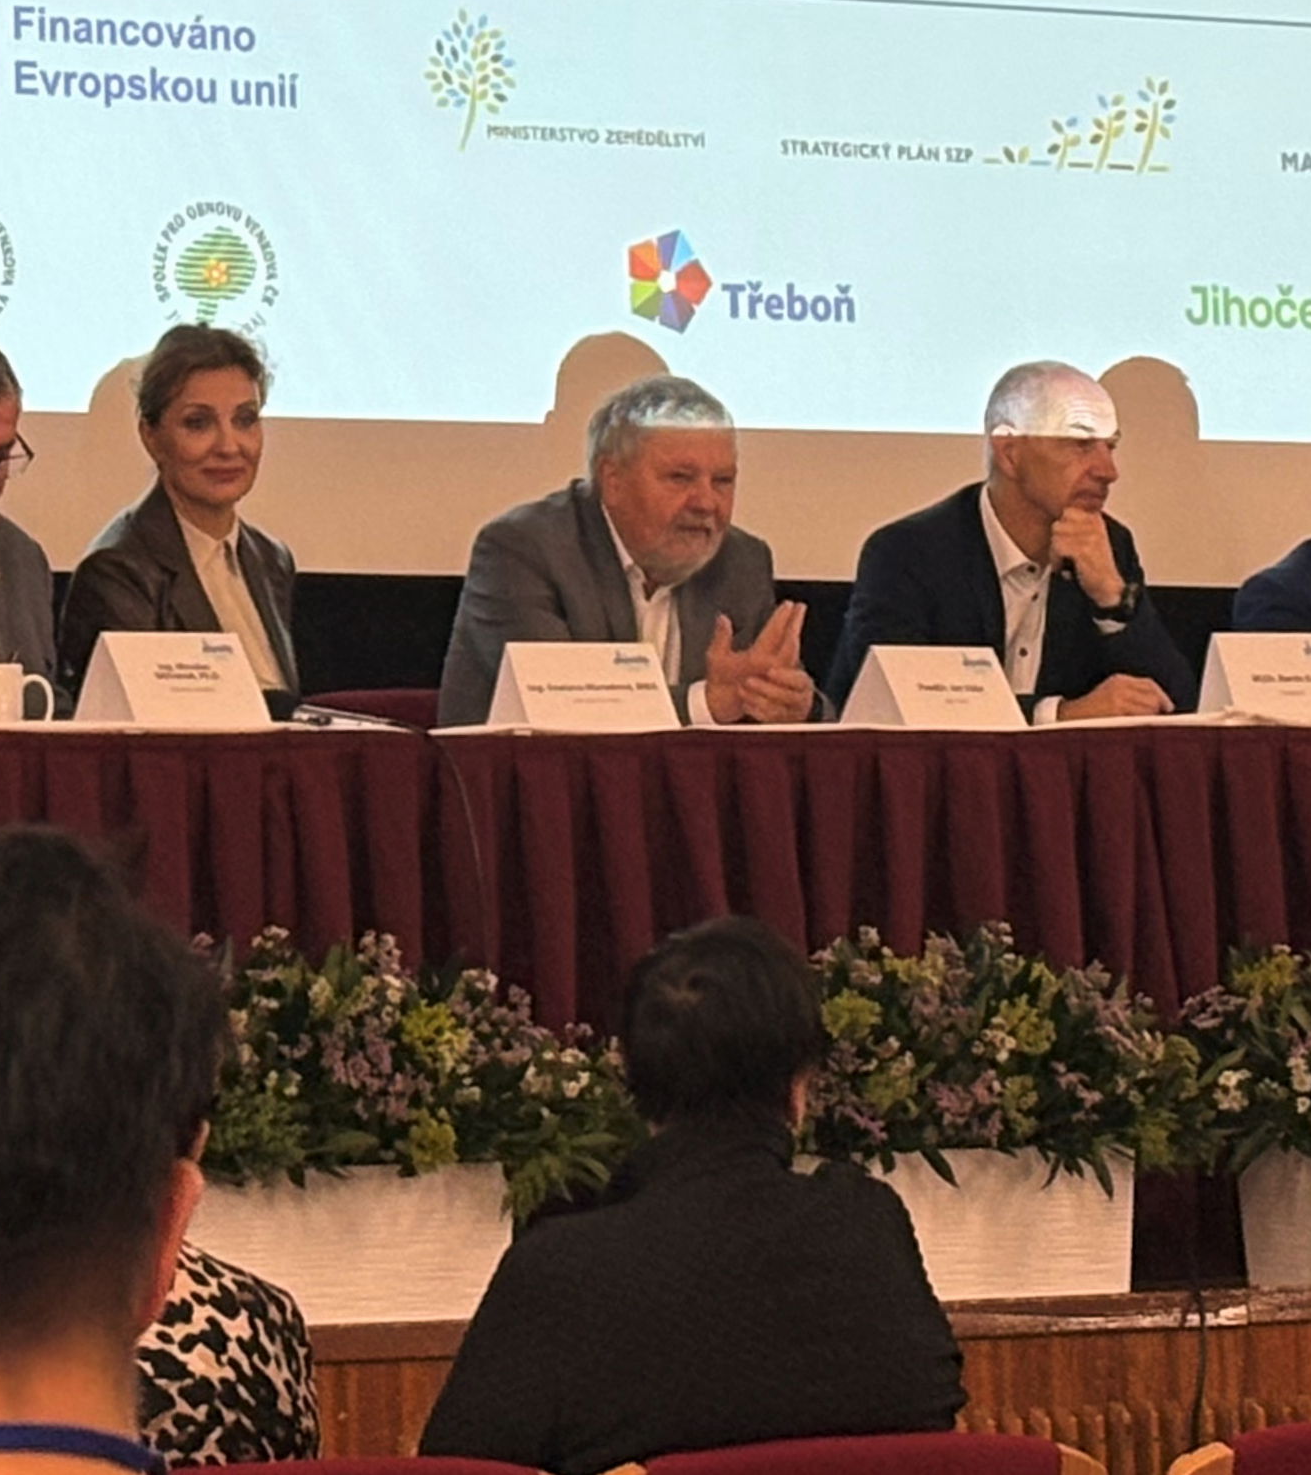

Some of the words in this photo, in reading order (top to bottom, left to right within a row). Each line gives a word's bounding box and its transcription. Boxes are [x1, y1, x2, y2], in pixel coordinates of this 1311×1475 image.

[13, 5, 256, 53] Financováno
[14, 59, 218, 109] Evropskou
[230, 72, 299, 109] unií
[486, 124, 601, 145] MINISTERSTVO
[604, 128, 706, 149] ZEMĚDĚLSTVÍ
[780, 139, 892, 160] STRATEGICKÝ
[897, 144, 940, 162] PLÁN
[944, 146, 974, 164] SZP
[160, 213, 186, 243] PRO
[185, 201, 243, 223] OBNOVU
[153, 242, 171, 304] SPOLEK
[720, 280, 856, 324] Třeboň
